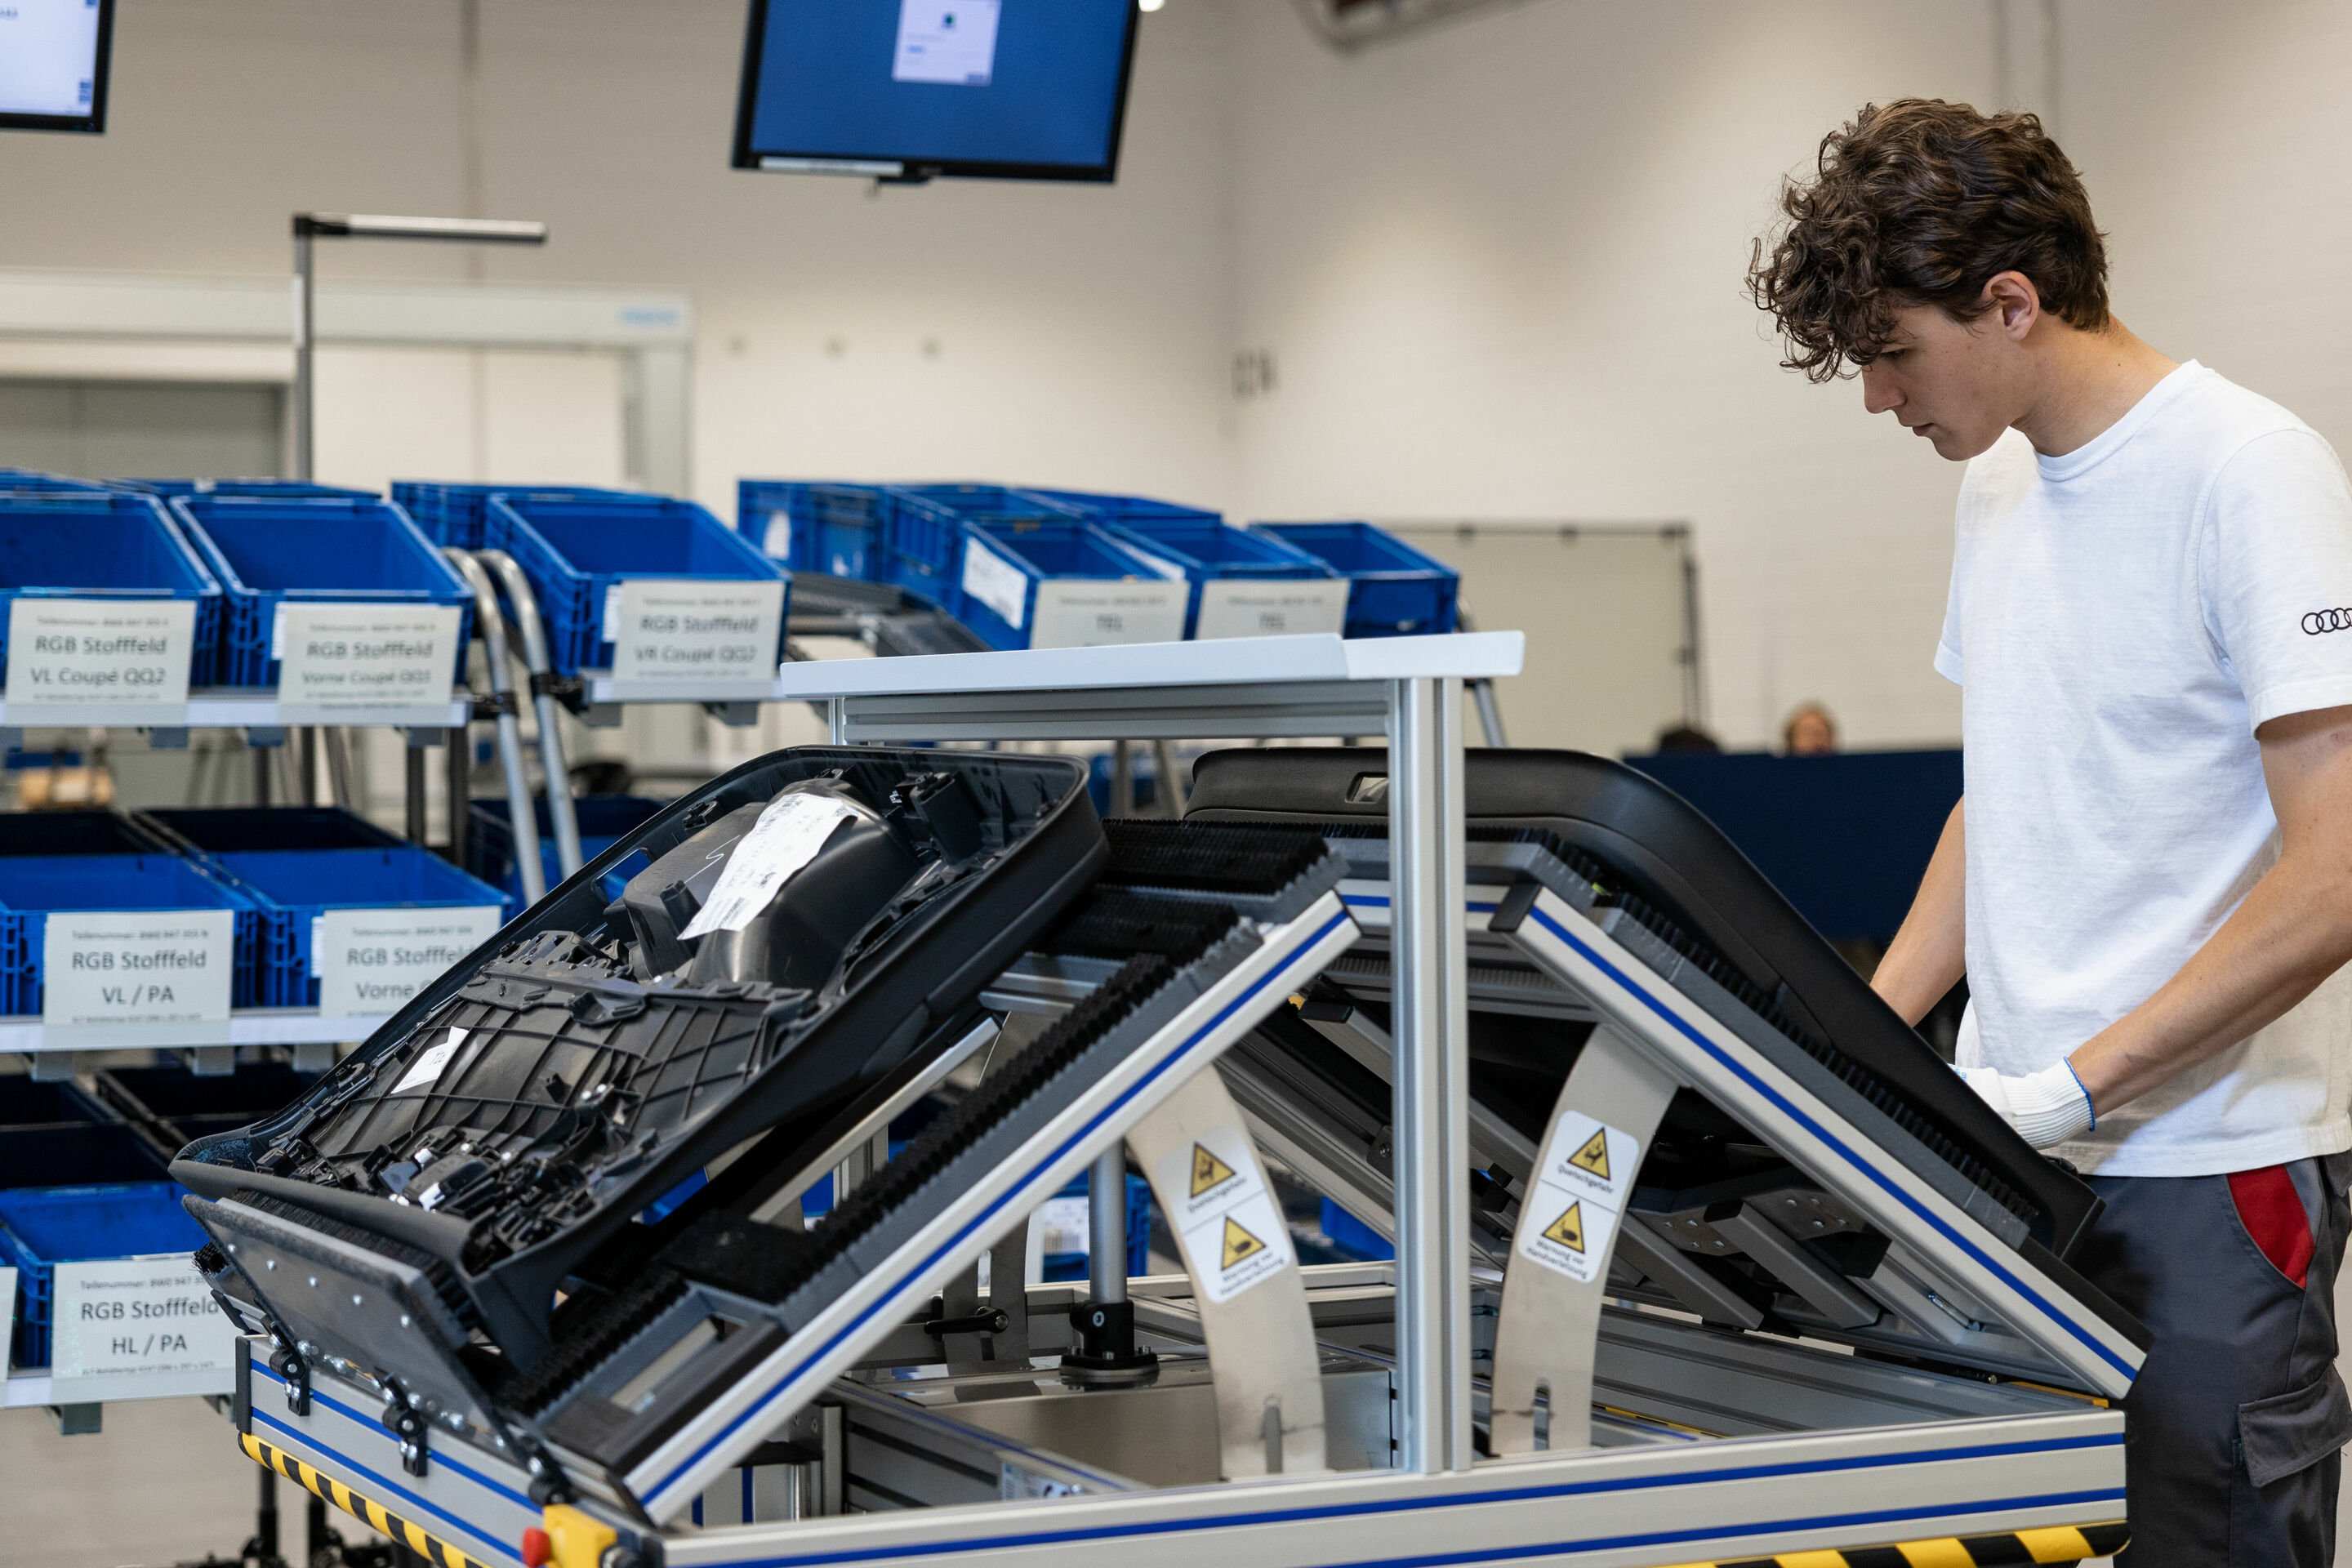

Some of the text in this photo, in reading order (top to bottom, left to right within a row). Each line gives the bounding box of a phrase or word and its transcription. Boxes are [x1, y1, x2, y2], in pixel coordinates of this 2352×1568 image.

[640, 615, 679, 633] RGB
[36, 634, 167, 654] RGB Stofffeld
[307, 641, 348, 659] RGB
[31, 666, 52, 684] VL
[58, 666, 119, 688] Coupé
[73, 949, 207, 970] RGB Stofffeld
[347, 947, 388, 965] RGB
[103, 984, 174, 1006] VL / PA
[356, 982, 414, 1000] Vorne
[82, 1301, 124, 1321] RGB
[112, 1333, 188, 1357] HL / PA
